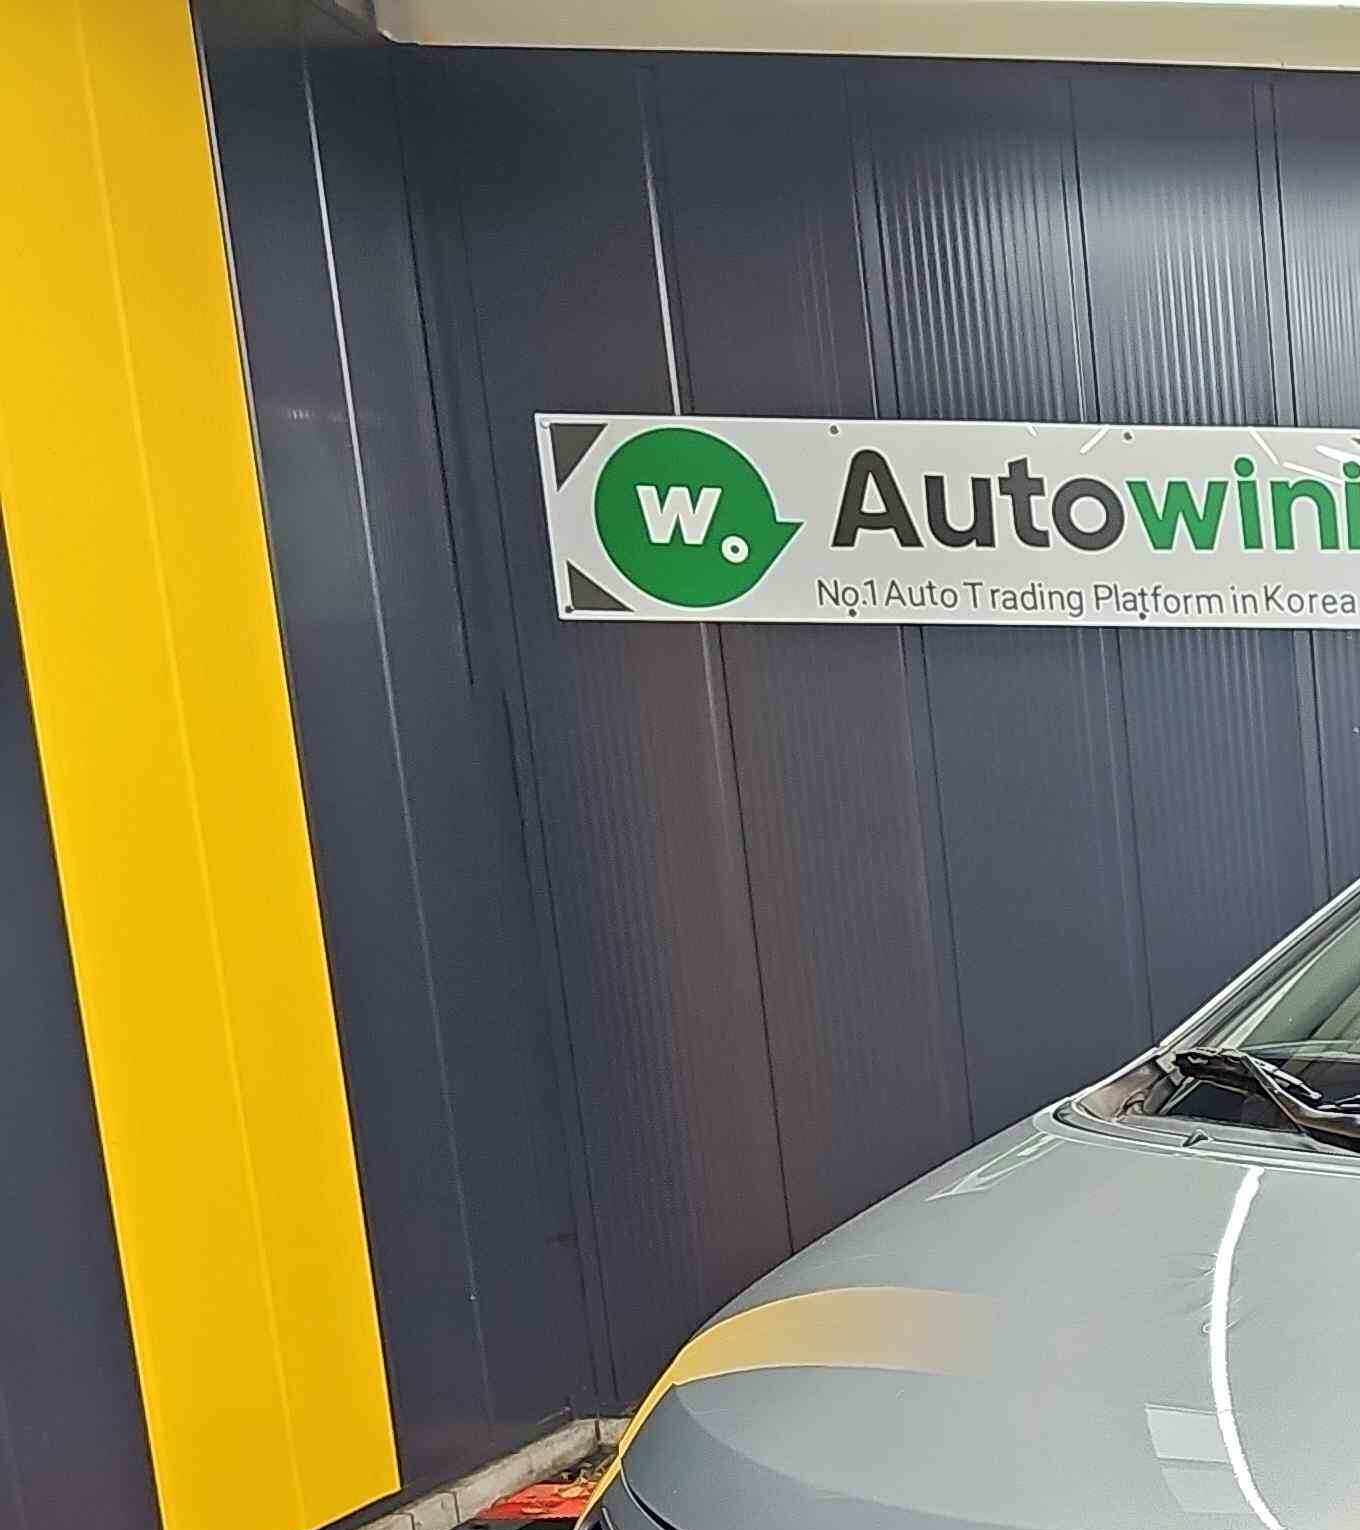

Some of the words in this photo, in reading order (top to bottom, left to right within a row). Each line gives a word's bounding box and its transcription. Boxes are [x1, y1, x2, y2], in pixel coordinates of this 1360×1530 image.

[816, 578, 878, 607] No.1
[883, 579, 959, 608] Auto
[962, 581, 1084, 618] Trading
[1093, 583, 1224, 614] Platform
[1230, 585, 1258, 614] in
[1263, 584, 1356, 614] Korea
